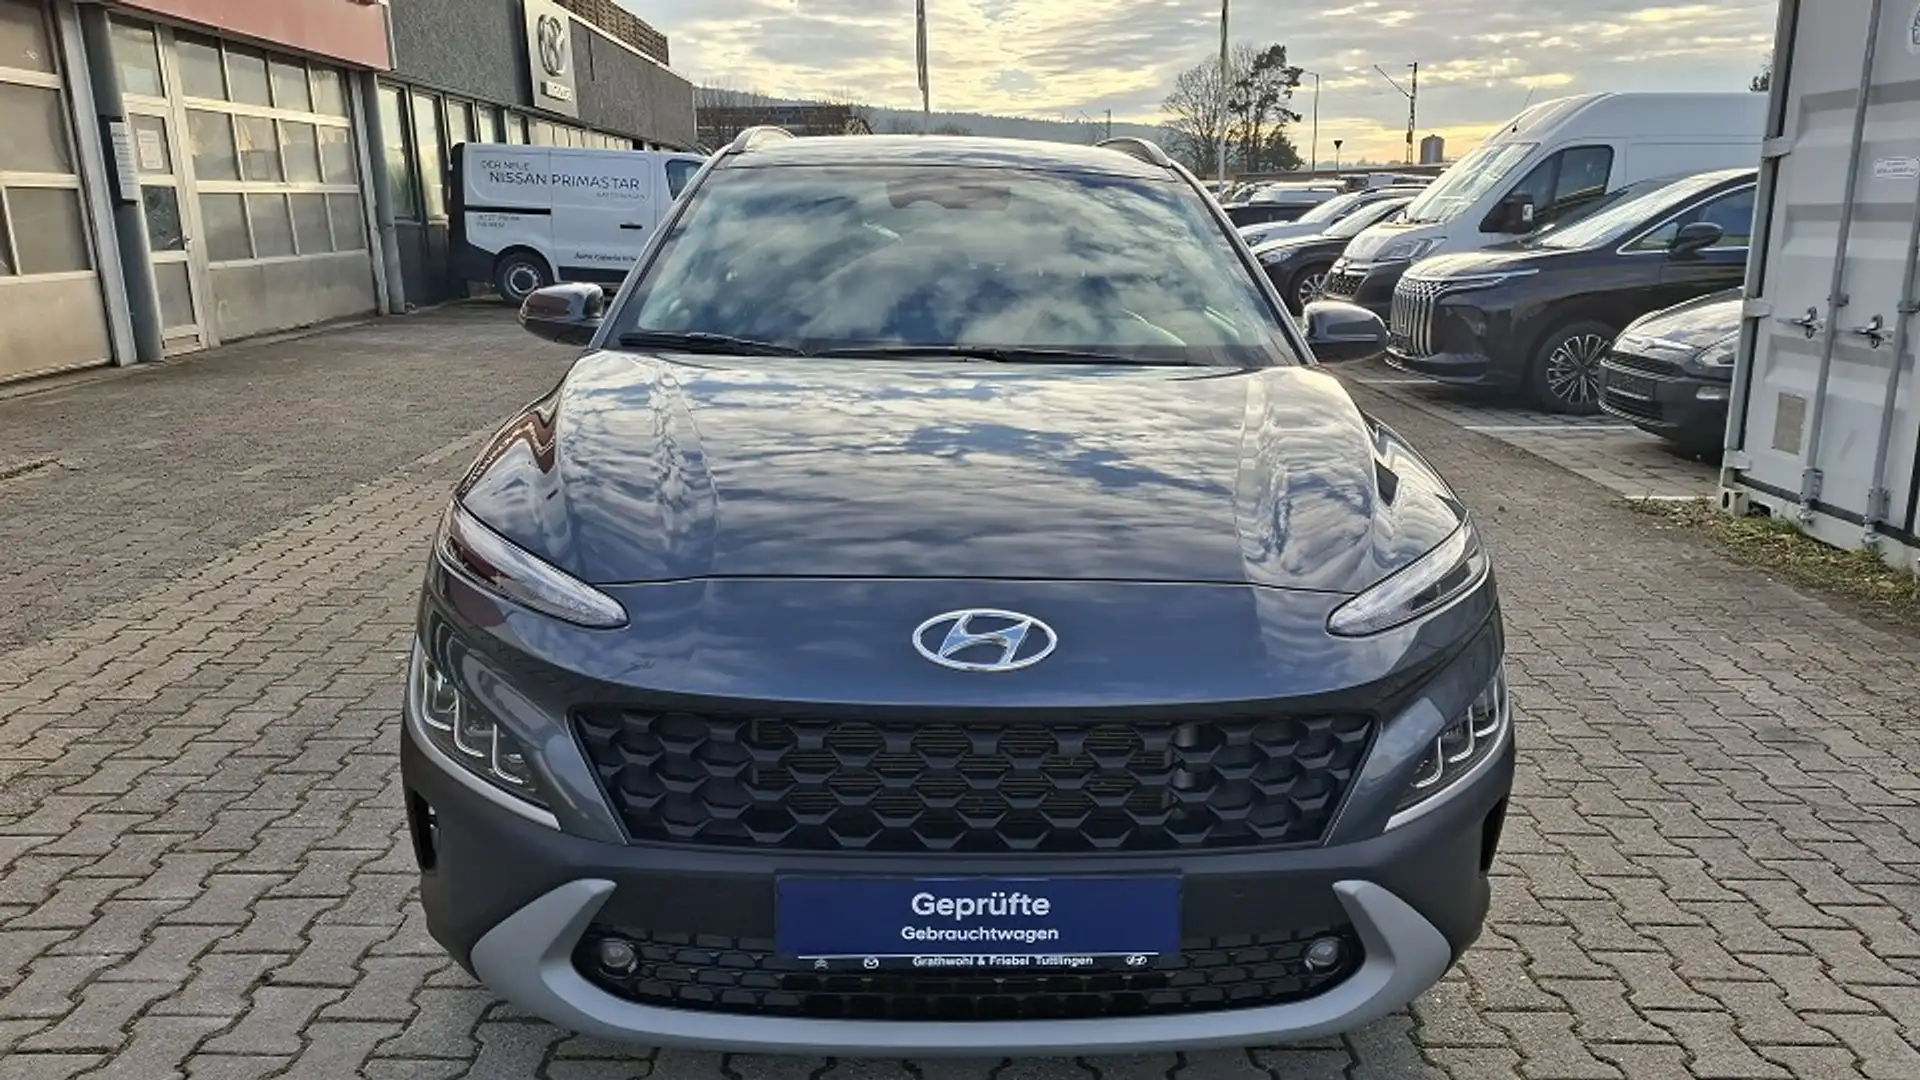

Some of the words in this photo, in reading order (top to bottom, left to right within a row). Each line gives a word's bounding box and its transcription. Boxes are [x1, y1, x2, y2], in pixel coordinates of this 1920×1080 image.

[489, 171, 547, 185] NISSAN
[551, 174, 640, 190] PRIMASTAR
[911, 891, 1051, 921] Geprüfte
[901, 925, 1059, 943] Gebrauchtwagen
[912, 955, 973, 967] Grathwohl
[977, 956, 985, 966] &
[989, 955, 1030, 966] Friebel
[1035, 955, 1093, 968] Tuttlingen
